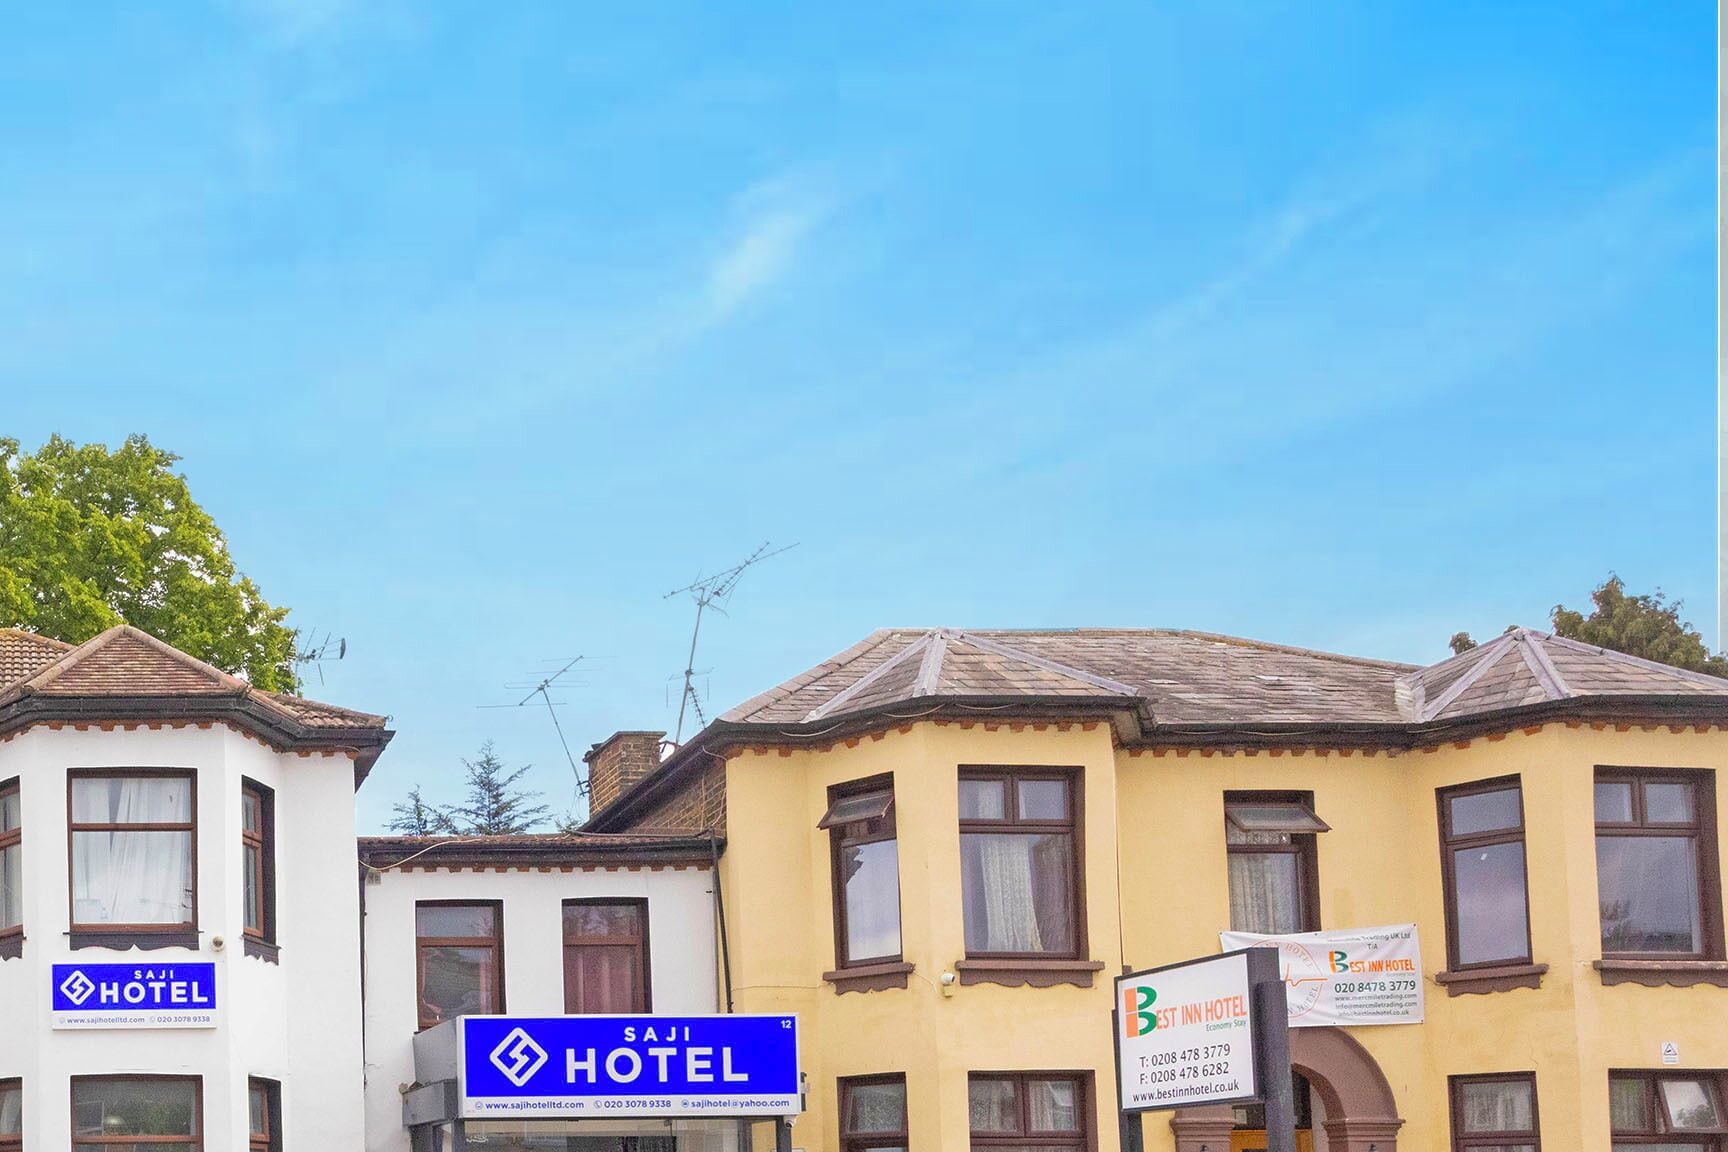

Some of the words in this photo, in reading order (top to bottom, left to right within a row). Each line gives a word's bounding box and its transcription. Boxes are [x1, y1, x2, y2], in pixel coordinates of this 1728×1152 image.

[1368, 960, 1385, 973] INN
[1385, 959, 1415, 972] HOTEL
[134, 970, 174, 979] SAJI
[100, 981, 208, 1003] HOTEL
[1334, 983, 1355, 994] 020
[1357, 982, 1386, 993] 8478
[1389, 980, 1416, 991] 3779
[1182, 1003, 1202, 1026] INN
[1205, 995, 1247, 1023] HOTEL
[781, 1020, 792, 1029] 12
[1206, 1021, 1232, 1032] Economy
[1234, 1018, 1246, 1027] Stay
[624, 1026, 690, 1042] SAJI
[1140, 1056, 1149, 1068] T:
[1151, 1051, 1177, 1067] 0208
[1180, 1048, 1200, 1062] 478
[1203, 1043, 1231, 1059] 3779
[566, 1047, 749, 1084] HOTEL
[1140, 1073, 1149, 1085] F:
[1150, 1069, 1176, 1083] 0208
[1179, 1065, 1199, 1079] 478
[1202, 1061, 1229, 1077] 6282
[1133, 1079, 1239, 1102] www.bestinnhotel.co.uk
[486, 1100, 585, 1110] www.sajihotelltd.com
[604, 1100, 622, 1108] 020
[625, 1100, 647, 1108] 3078
[649, 1100, 671, 1108] 9338
[691, 1099, 789, 1109] sajihotel@yahoo.com
